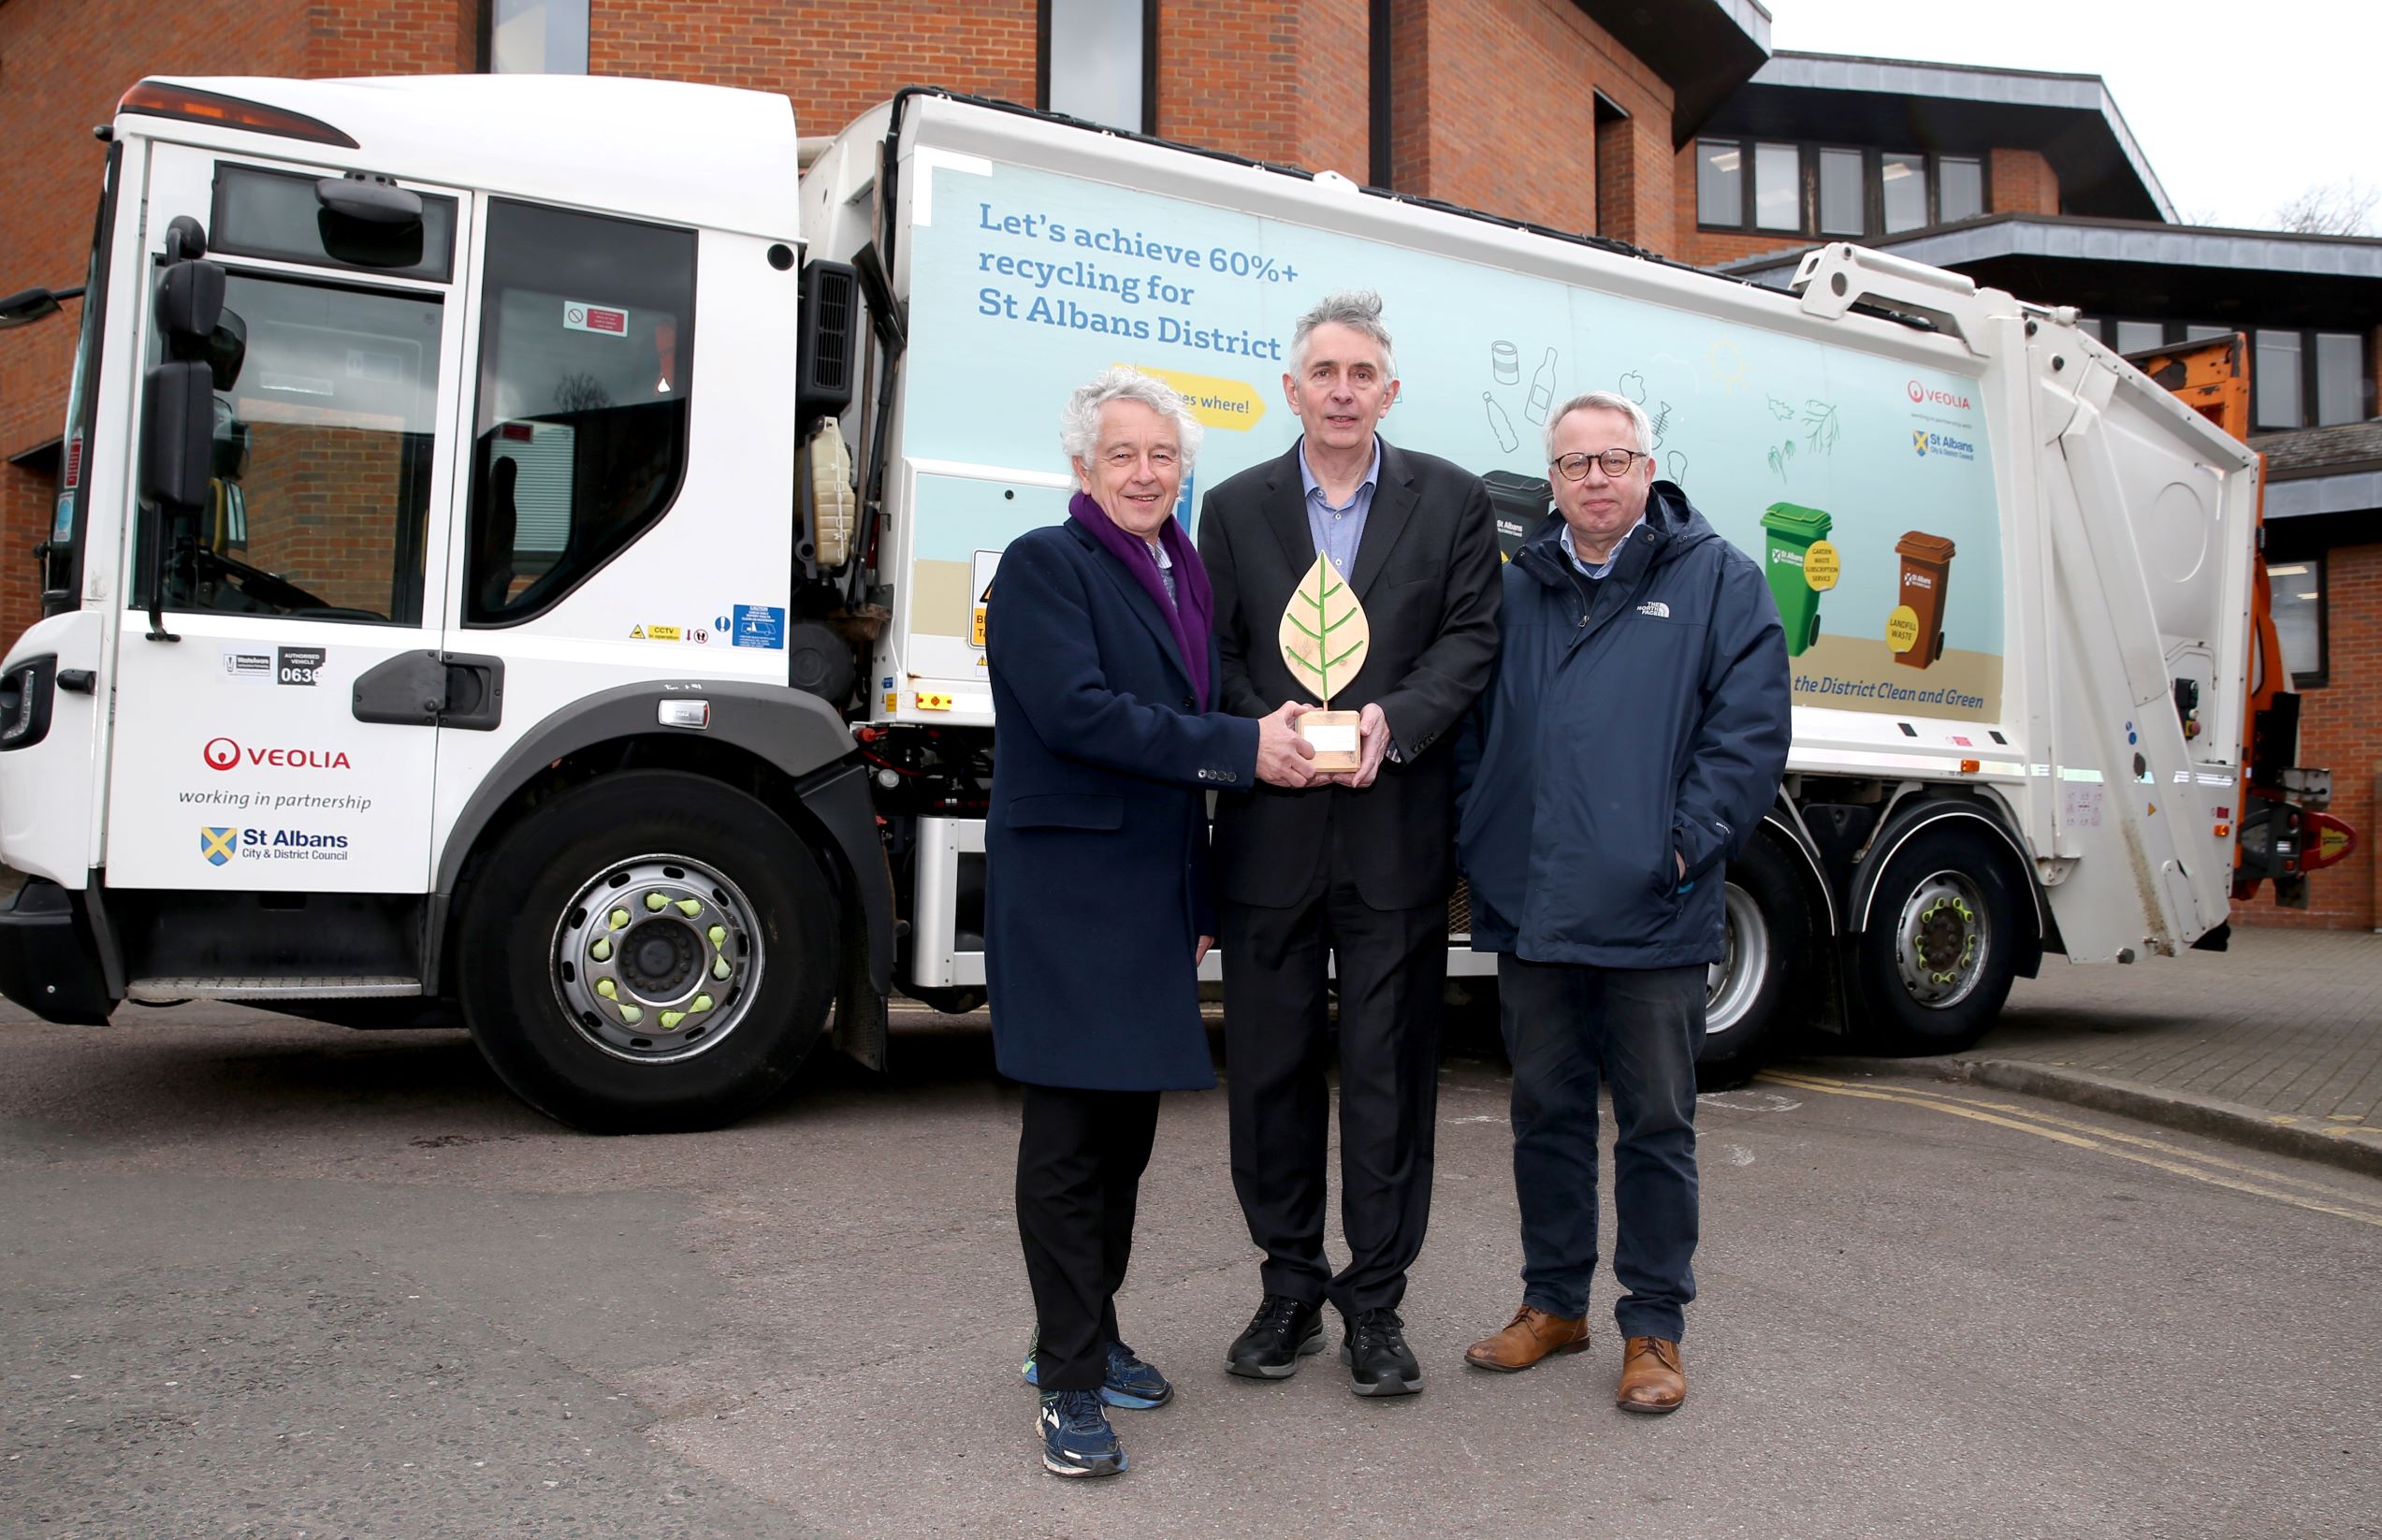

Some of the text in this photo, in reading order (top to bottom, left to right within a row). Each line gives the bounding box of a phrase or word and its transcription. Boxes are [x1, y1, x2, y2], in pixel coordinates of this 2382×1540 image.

[980, 203, 1299, 283] Let’s achieve 60%+
[979, 252, 1195, 306] recycling for
[979, 287, 1282, 361] St Albans District
[1200, 395, 1249, 414] where!
[1925, 388, 1971, 410] VEOLIA
[1930, 433, 1973, 453] St Albans
[1890, 618, 1917, 632] LANDFILL
[1891, 630, 1912, 641] WASTE
[1794, 675, 1983, 709] the District Clean and Green
[247, 748, 351, 769] VEOLIA
[179, 790, 371, 813] working in partnership
[242, 828, 348, 848] St Albans
[242, 849, 348, 861] City & District Council
